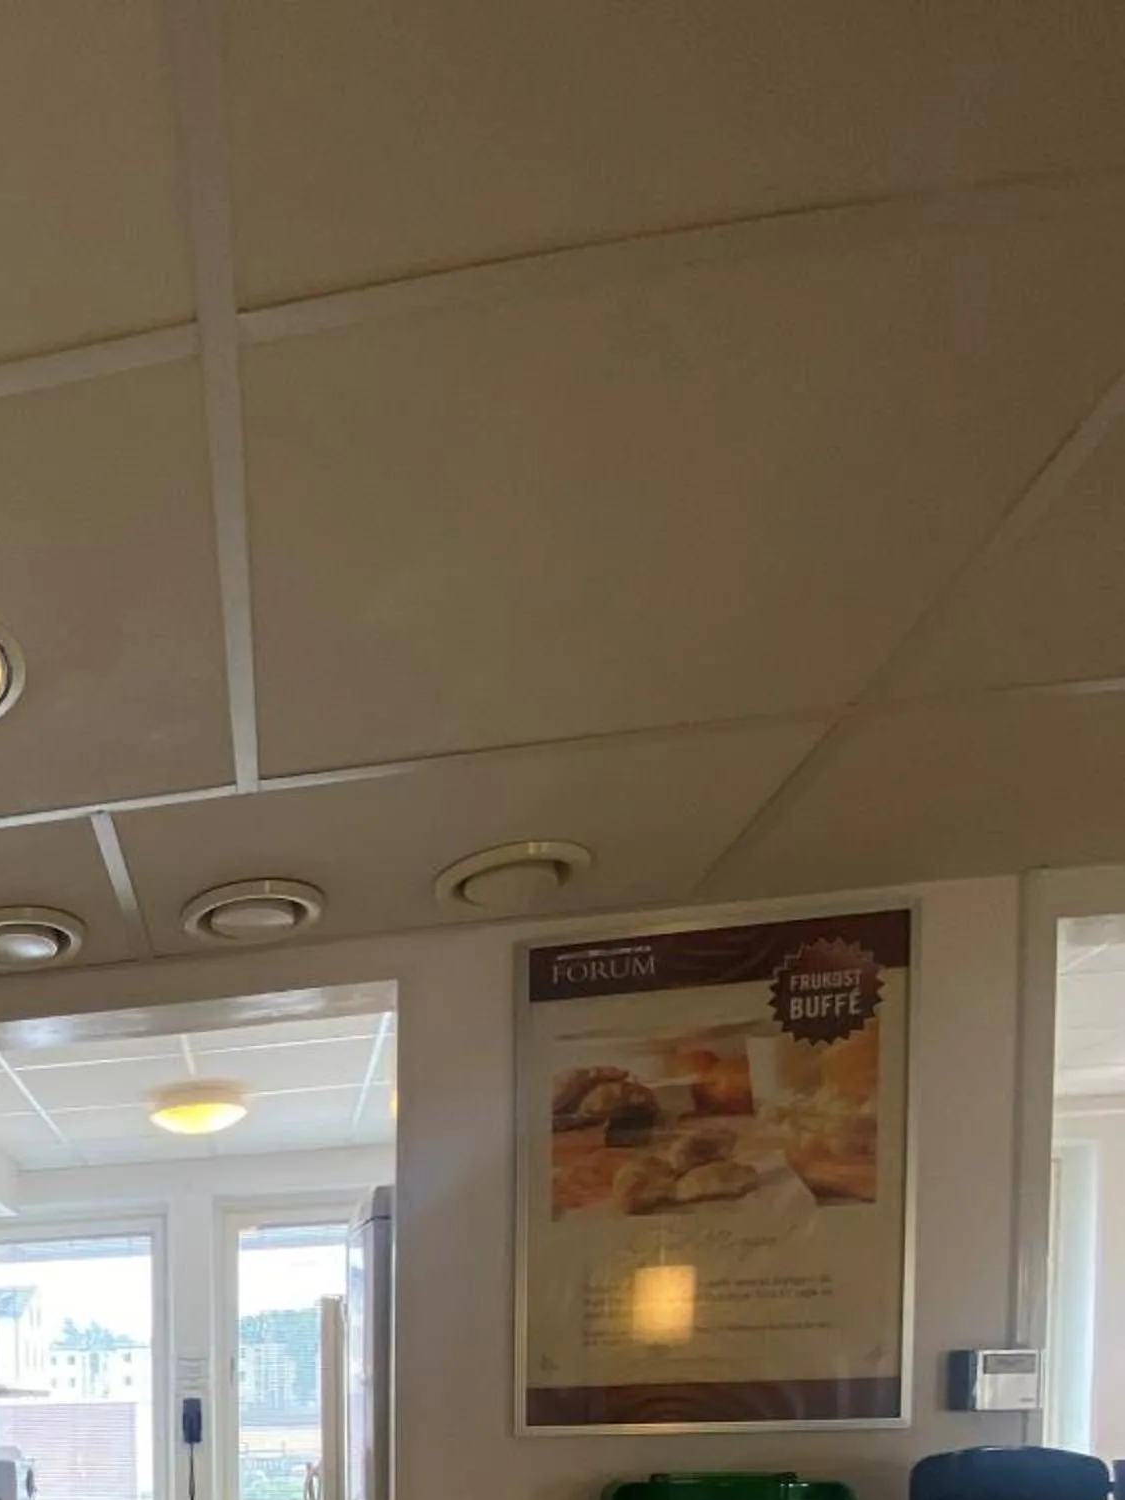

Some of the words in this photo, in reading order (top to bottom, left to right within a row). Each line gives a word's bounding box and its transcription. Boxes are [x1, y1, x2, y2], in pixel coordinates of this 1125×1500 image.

[551, 955, 655, 985] FORUM
[789, 969, 862, 992] FRUKOST
[789, 987, 862, 1020] BUFFÉ
